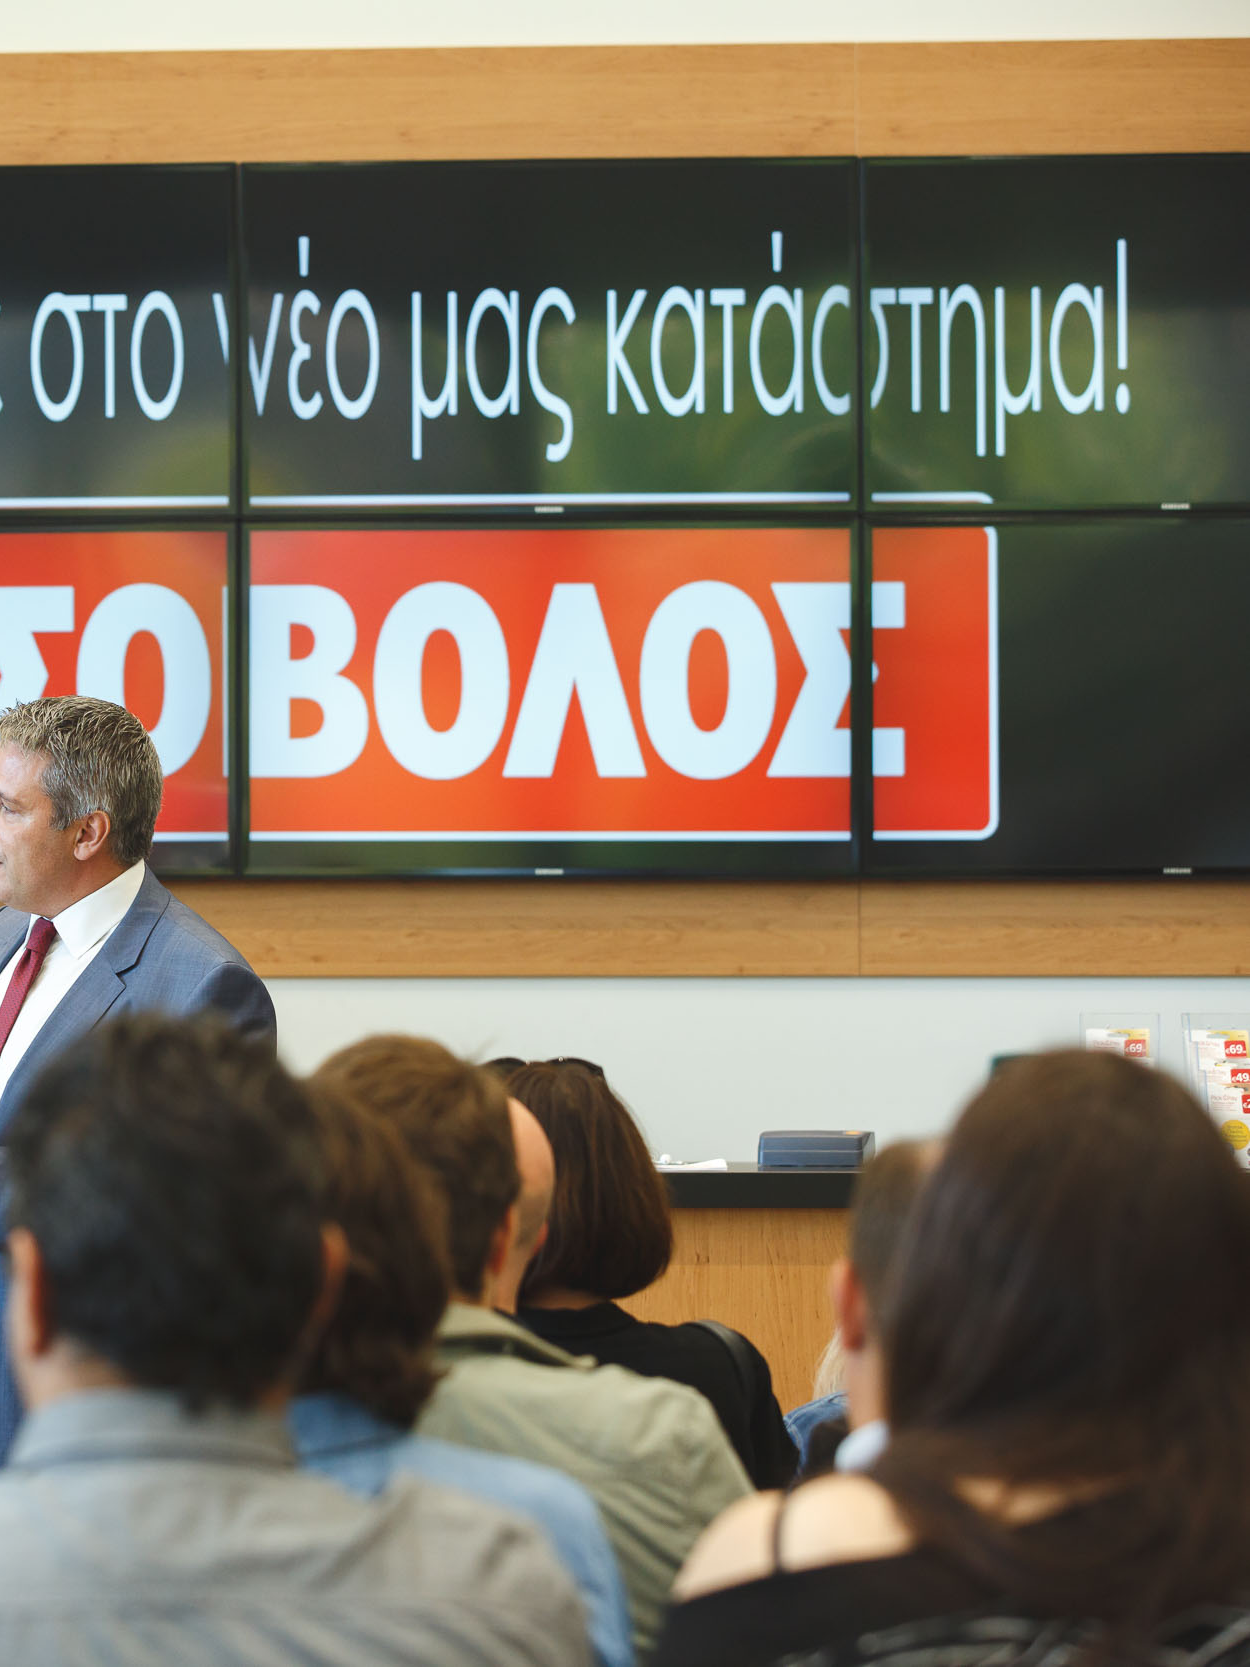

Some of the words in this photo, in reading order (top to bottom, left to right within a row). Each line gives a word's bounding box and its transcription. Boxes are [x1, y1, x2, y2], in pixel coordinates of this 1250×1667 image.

[30, 291, 184, 422] στο
[213, 236, 380, 420] νέο
[411, 287, 576, 462] μας
[606, 231, 1131, 457] κατάστημα!
